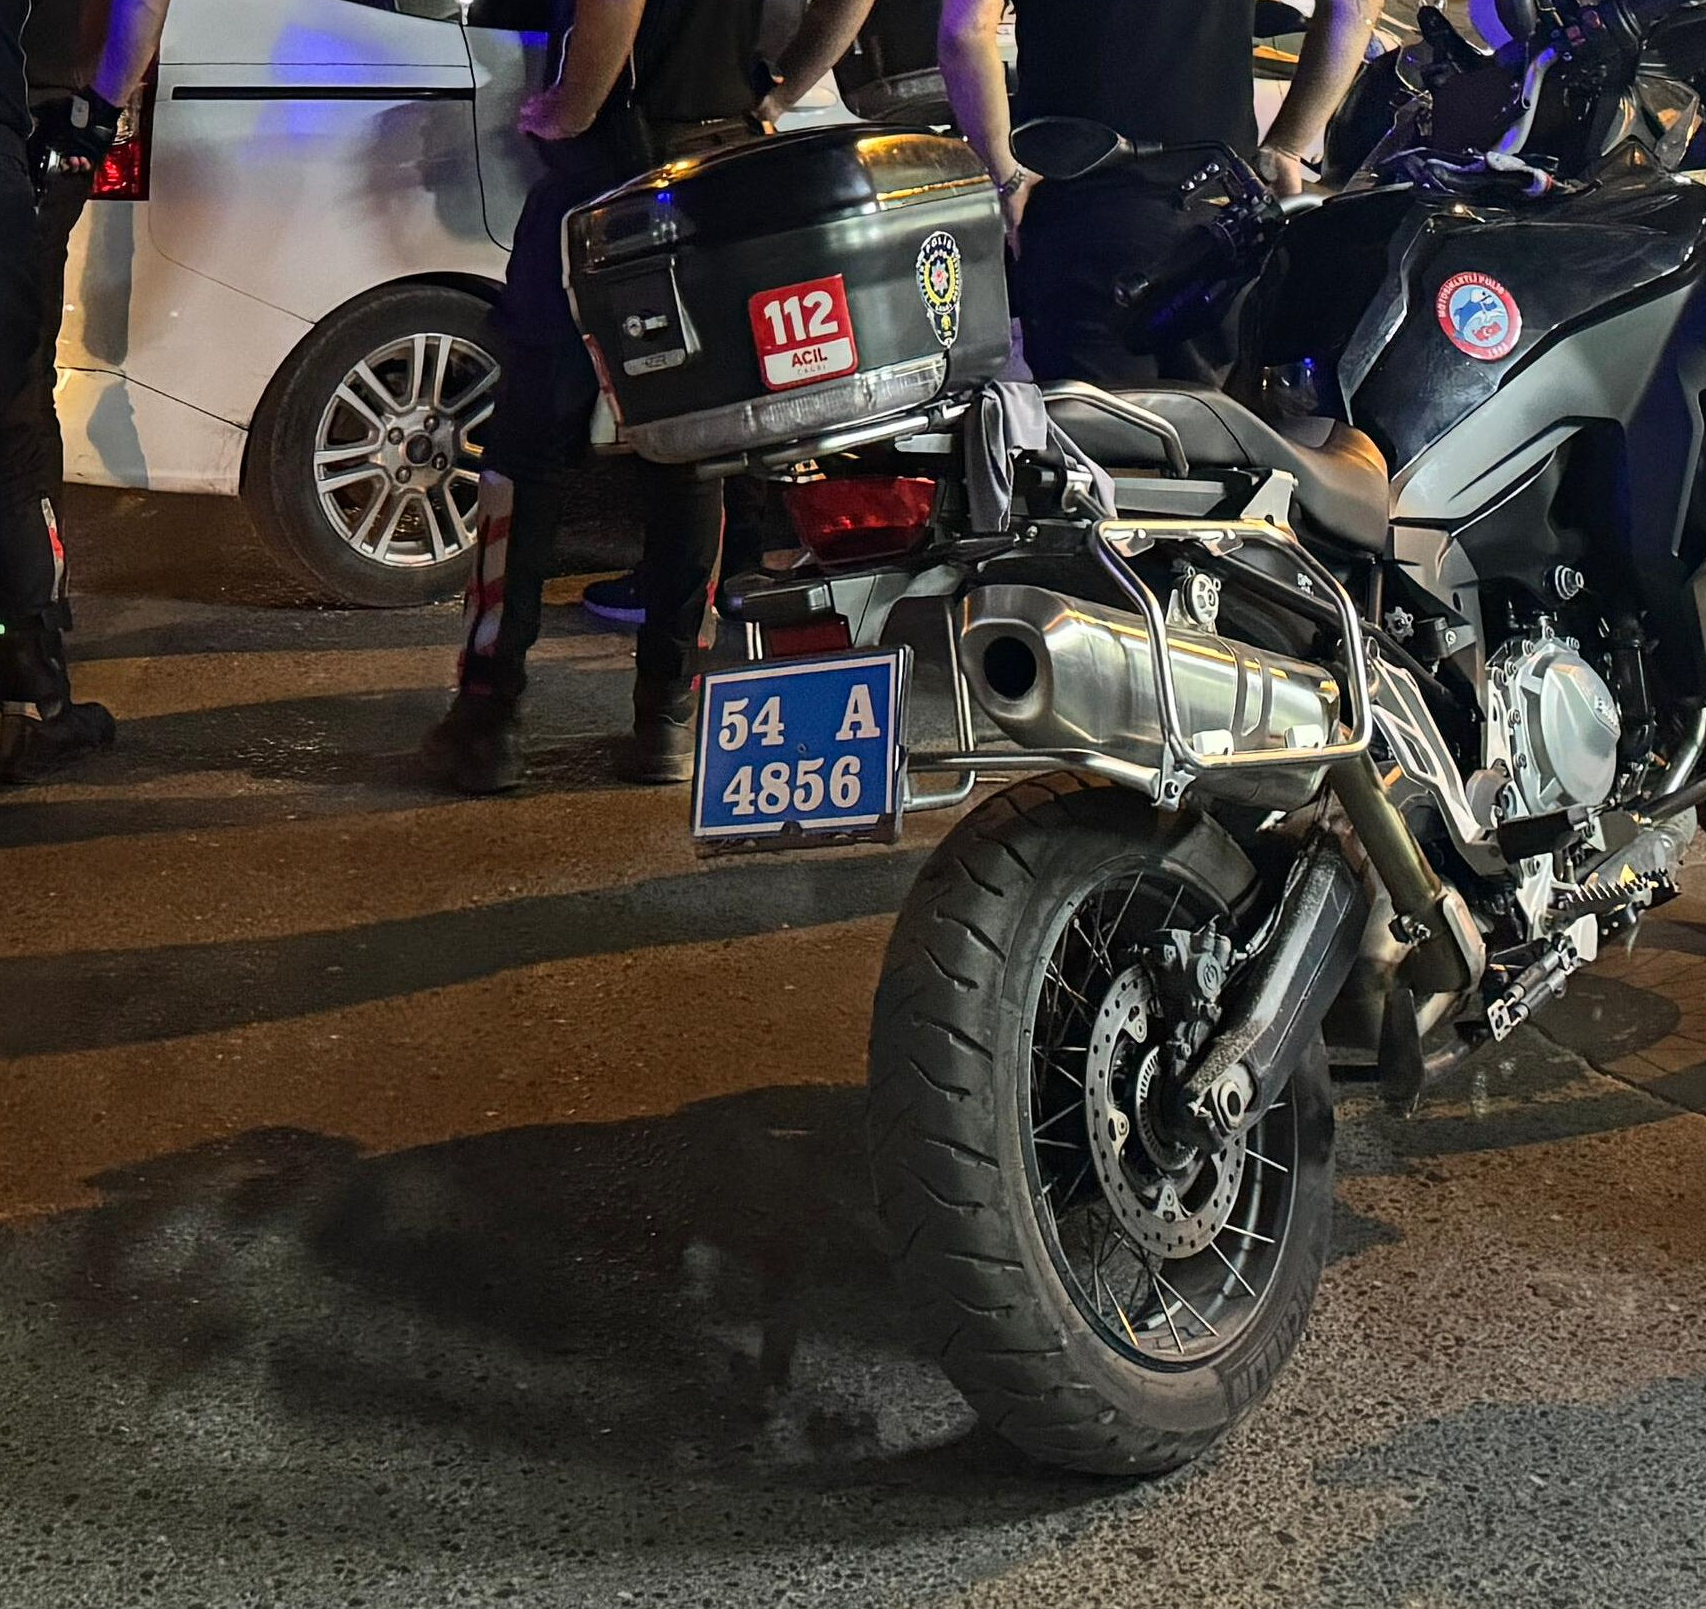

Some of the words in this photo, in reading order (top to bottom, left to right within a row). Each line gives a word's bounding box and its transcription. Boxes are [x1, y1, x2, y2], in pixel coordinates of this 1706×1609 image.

[763, 290, 839, 345] 112
[718, 695, 785, 751] 54
[835, 683, 881, 741] A
[722, 754, 862, 816] 4856
